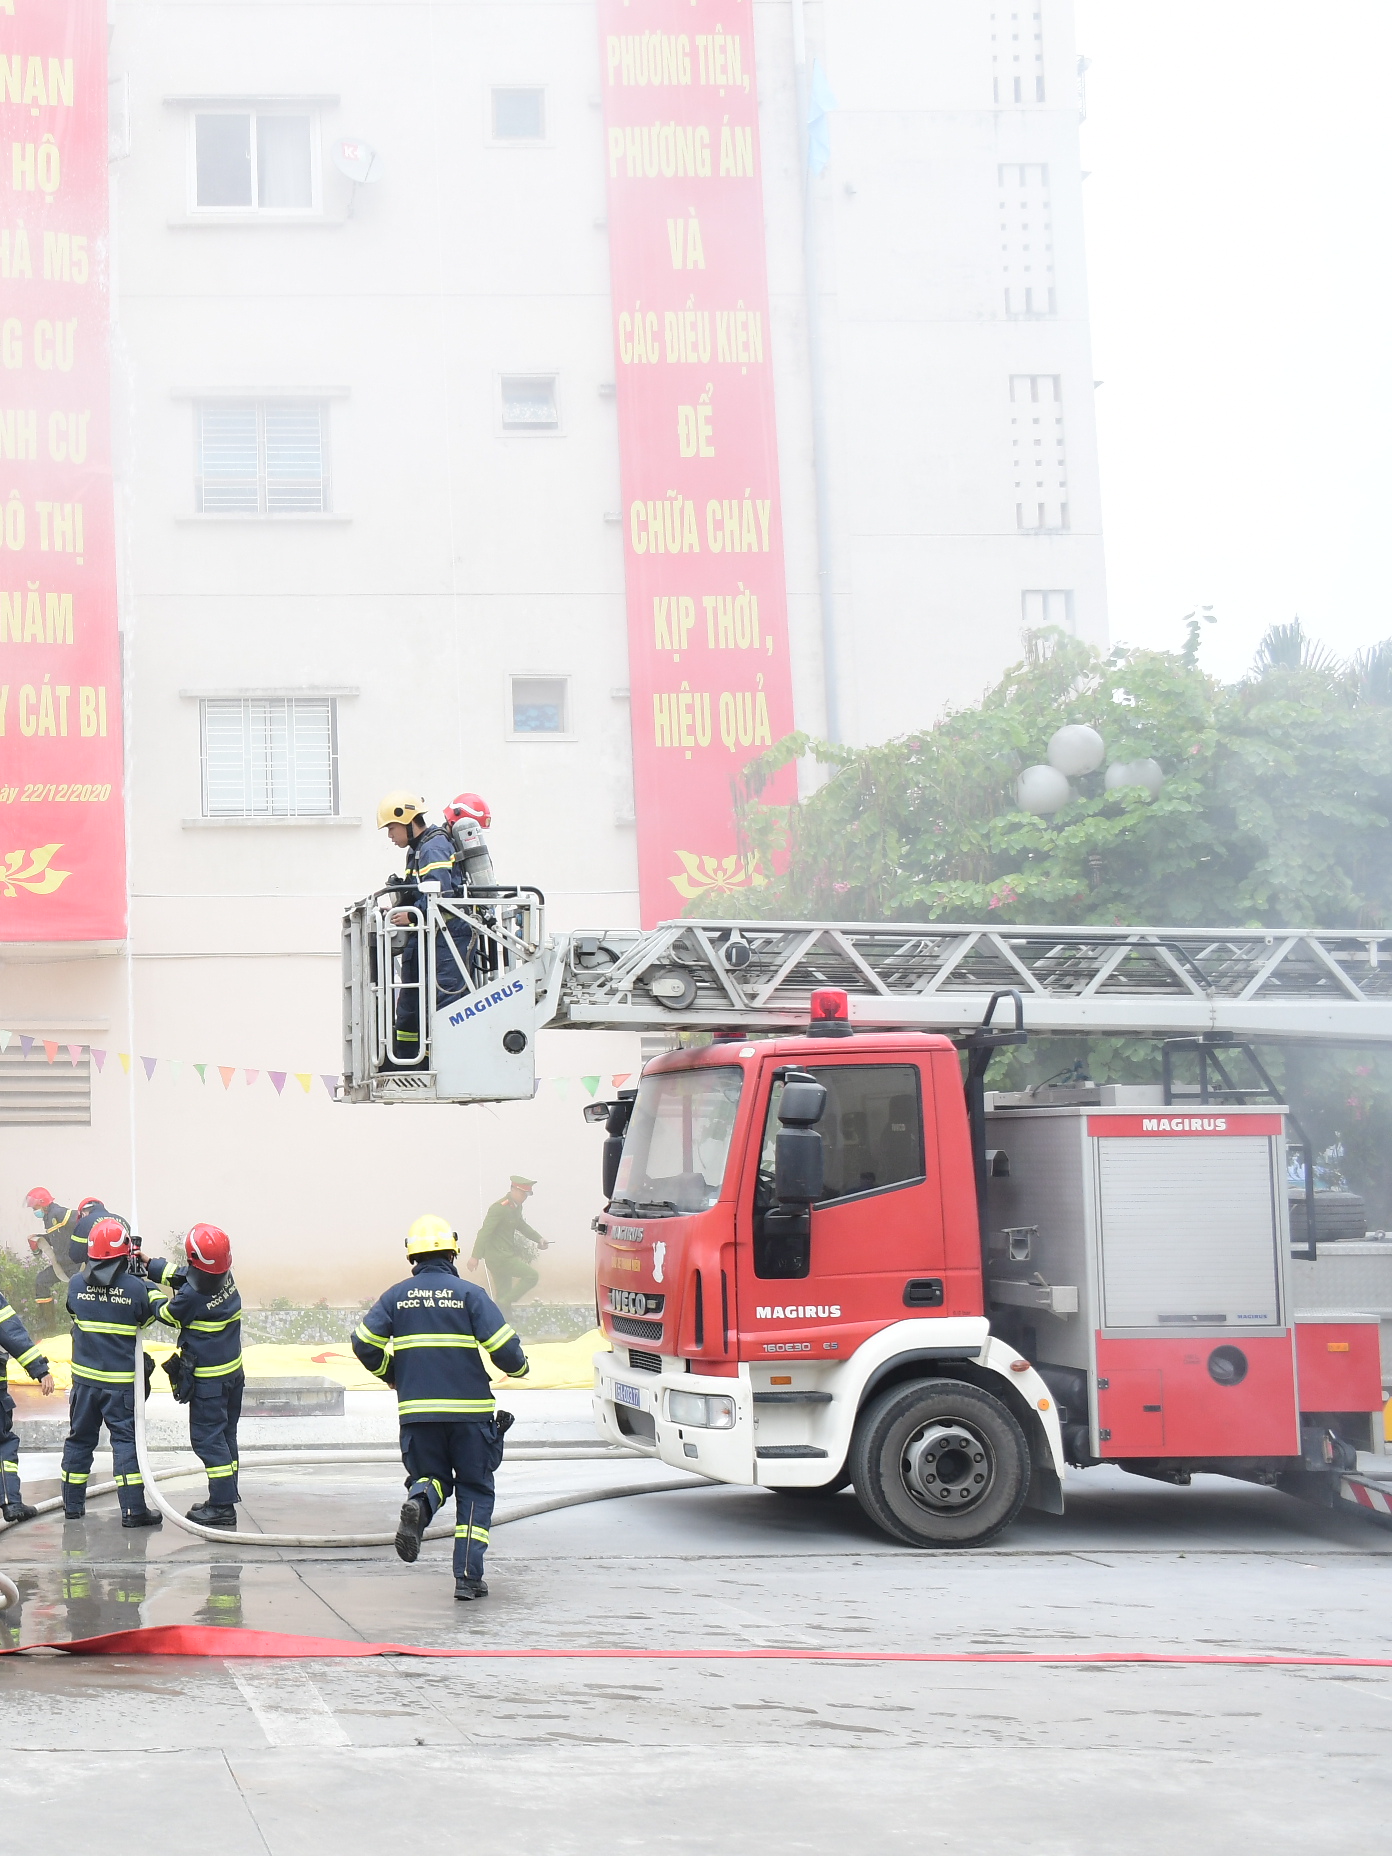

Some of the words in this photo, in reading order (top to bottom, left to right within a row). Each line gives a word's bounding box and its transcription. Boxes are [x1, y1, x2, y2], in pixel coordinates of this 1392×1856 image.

[607, 29, 691, 87] PHƯƠNG
[695, 23, 750, 97] TIỆN,
[12, 133, 61, 203] HỘ
[610, 120, 711, 178] PHƯƠNG
[719, 114, 754, 178] ÁN
[43, 231, 89, 285] M5
[666, 206, 706, 270] VÀ
[34, 317, 78, 372] CƯ
[618, 300, 660, 365] CÁC
[664, 293, 710, 364] ĐIỀU
[715, 300, 764, 375] KIỆN
[47, 408, 91, 464] CƯ
[677, 383, 715, 458] ĐỂ
[35, 502, 84, 565] THỊ
[630, 489, 700, 554] CHỮA
[705, 487, 771, 553] CHÁY
[0, 580, 74, 644] NĂM
[653, 596, 695, 663] KỊP
[18, 674, 70, 738] CÁT
[79, 685, 108, 738] BI
[653, 681, 711, 759] HIỆU
[719, 672, 772, 753] QUẢ
[20, 783, 112, 802] 22/12/2020
[448, 979, 525, 1027] MAGIRUS
[1142, 1118, 1227, 1131] MAGIRUS
[611, 1225, 644, 1242] MAGIRUS
[77, 1293, 96, 1301] PCCC
[110, 1296, 132, 1305] CNCH
[108, 1286, 124, 1296] SÁT
[396, 1299, 421, 1310] PCCC
[423, 1298, 436, 1308] VÀ
[438, 1299, 464, 1309] CNCH
[407, 1288, 433, 1298] CẢNH
[434, 1288, 454, 1298] SÁT
[610, 1288, 646, 1316] IVECO
[756, 1305, 841, 1319] MAGIRUS
[762, 1342, 811, 1353] 160E30
